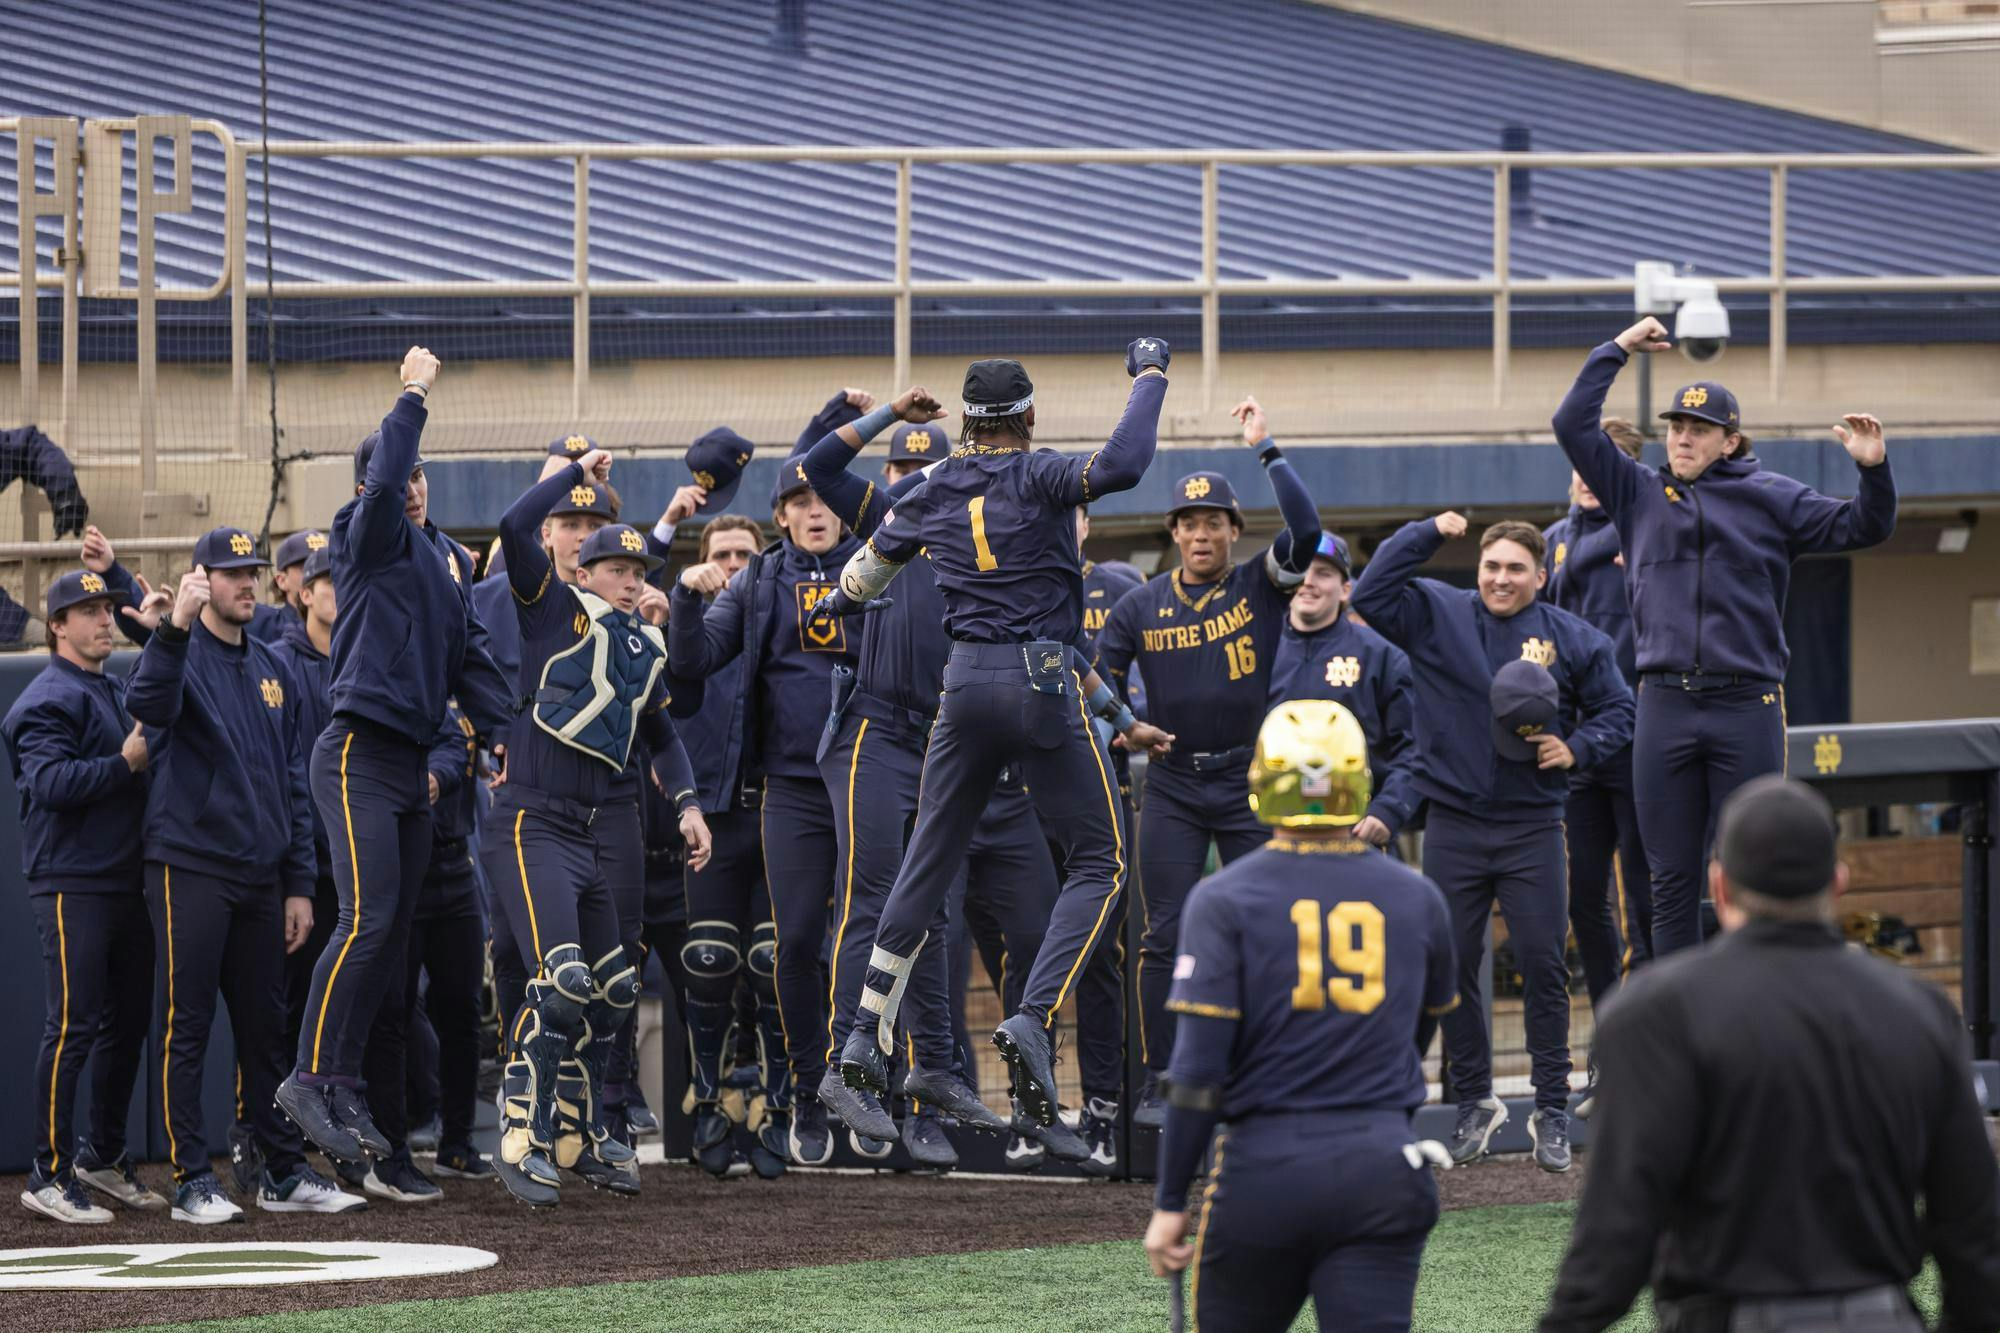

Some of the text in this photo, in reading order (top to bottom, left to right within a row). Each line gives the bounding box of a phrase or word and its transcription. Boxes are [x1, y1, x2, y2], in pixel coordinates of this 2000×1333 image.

[968, 496, 998, 572] 1
[1142, 598, 1254, 651] NOTRE DAME
[1224, 635, 1256, 680] 16
[1290, 898, 1386, 1014] 19
